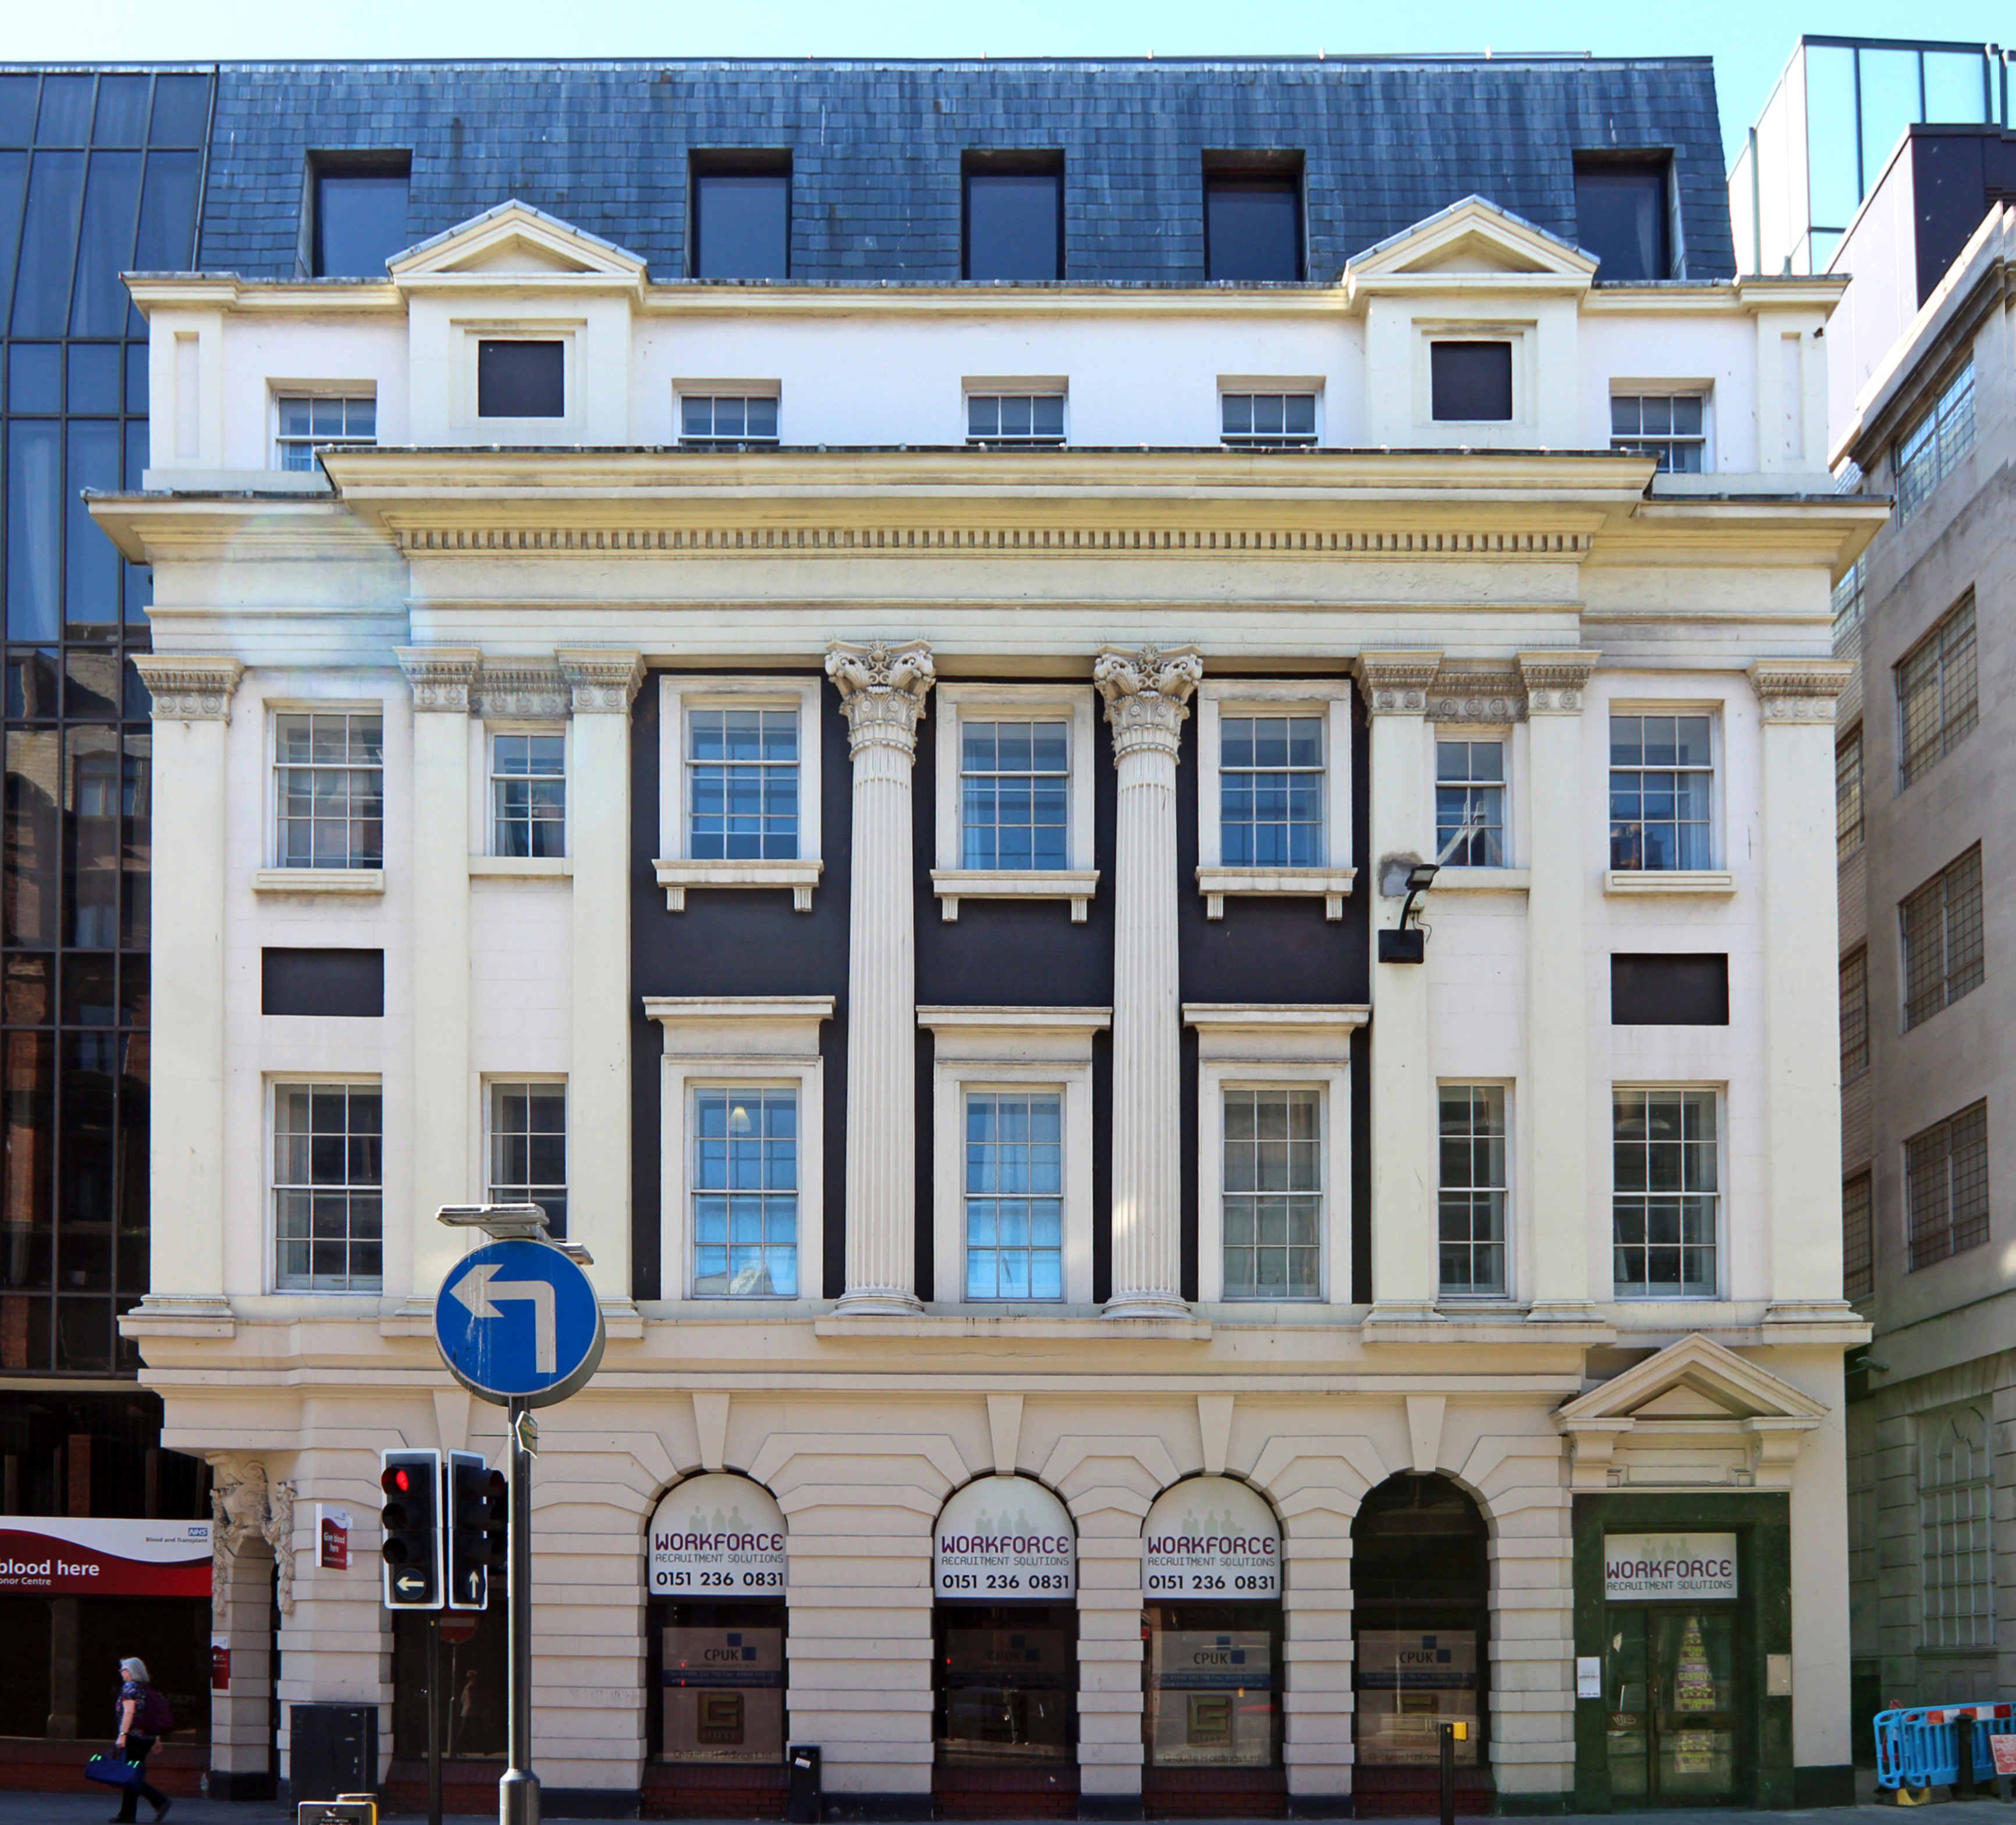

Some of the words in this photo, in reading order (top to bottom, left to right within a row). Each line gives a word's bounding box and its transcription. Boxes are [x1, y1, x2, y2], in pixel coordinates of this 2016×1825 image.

[323, 1532, 333, 1542] Give
[334, 1534, 346, 1544] blood
[655, 1533, 783, 1551] WORKFORCE
[330, 1543, 339, 1553] here
[941, 1535, 1069, 1554] WORKFORCE
[1148, 1536, 1275, 1554] WORKFORCE
[655, 1553, 724, 1563] RECRUITMENT
[728, 1554, 784, 1563] SOLUTIONS
[941, 1556, 1009, 1566] RECRUITMENT
[1014, 1557, 1069, 1566] SOLUTIONS
[1148, 1557, 1215, 1566] RECRUITMENT
[1219, 1557, 1275, 1566] SOLUTIONS
[57, 1560, 100, 1576] here
[1606, 1560, 1732, 1579] WORKFORCE
[21, 1577, 52, 1585] Centre
[656, 1572, 691, 1585] 0151
[700, 1572, 734, 1586] 236
[743, 1572, 783, 1586] 0831
[943, 1574, 977, 1589] 0151
[986, 1574, 1020, 1589] 236
[1029, 1574, 1069, 1589] 0831
[1149, 1575, 1183, 1589] 0151
[1192, 1575, 1226, 1589] 236
[1235, 1575, 1274, 1590] 0831
[1606, 1581, 1673, 1591] RECRUITMENT
[1677, 1579, 1732, 1589] SOLUTIONS
[705, 1648, 739, 1661] CPUK
[1193, 1652, 1228, 1664] CPUK
[1399, 1652, 1434, 1663] CPUK
[1201, 1754, 1241, 1763] Holdings
